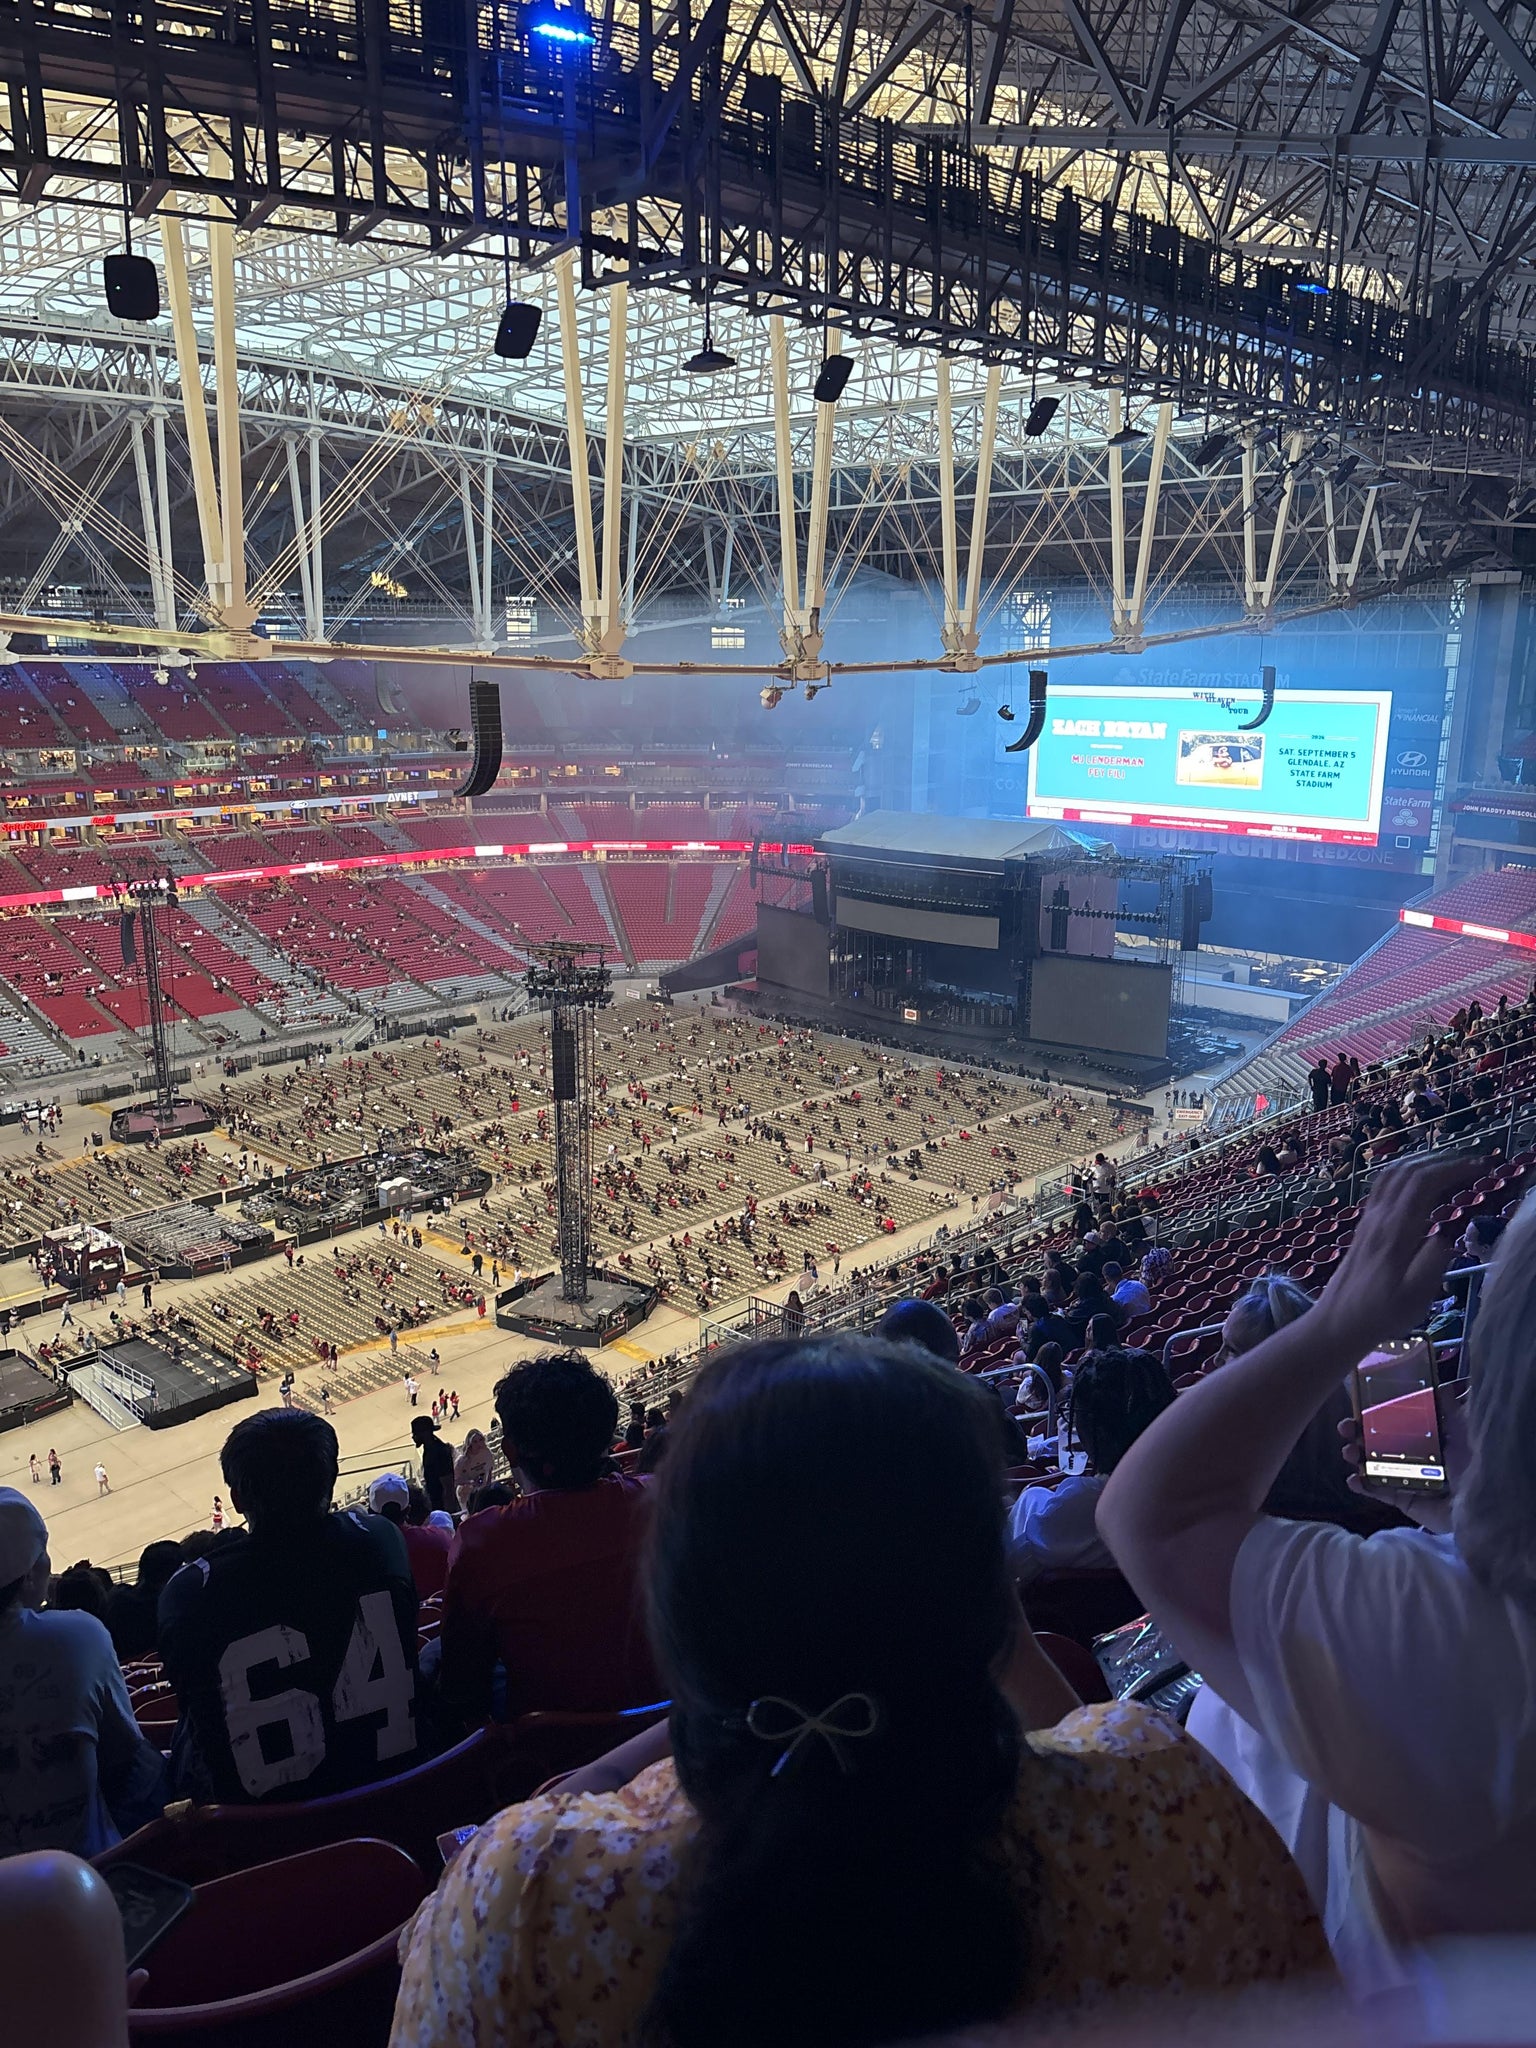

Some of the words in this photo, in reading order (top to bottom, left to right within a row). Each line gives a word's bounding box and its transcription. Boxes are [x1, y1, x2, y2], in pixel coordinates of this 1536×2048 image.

[1223, 674, 1290, 688] STADM
[1229, 707, 1249, 715] TOUR
[1052, 719, 1101, 736] ZACH
[1103, 721, 1167, 739] BRYAN
[1297, 749, 1349, 759] SEPTEMBER
[1350, 751, 1356, 759] 5
[1072, 755, 1085, 764] MJ
[1086, 756, 1145, 767] LENDERMAN
[1333, 761, 1345, 769] AZ
[1290, 769, 1315, 778] STATE
[1317, 771, 1341, 779] FARM
[1391, 767, 1430, 777] HYUNDAI
[1296, 780, 1333, 789] STADIUM
[1463, 804, 1479, 812] JOHN
[1480, 806, 1505, 815] (PADDY)
[1139, 829, 1197, 850] BUD
[1202, 833, 1290, 859] LIGHT
[1312, 844, 1394, 865] REDZONE
[217, 1590, 418, 1798] 64
